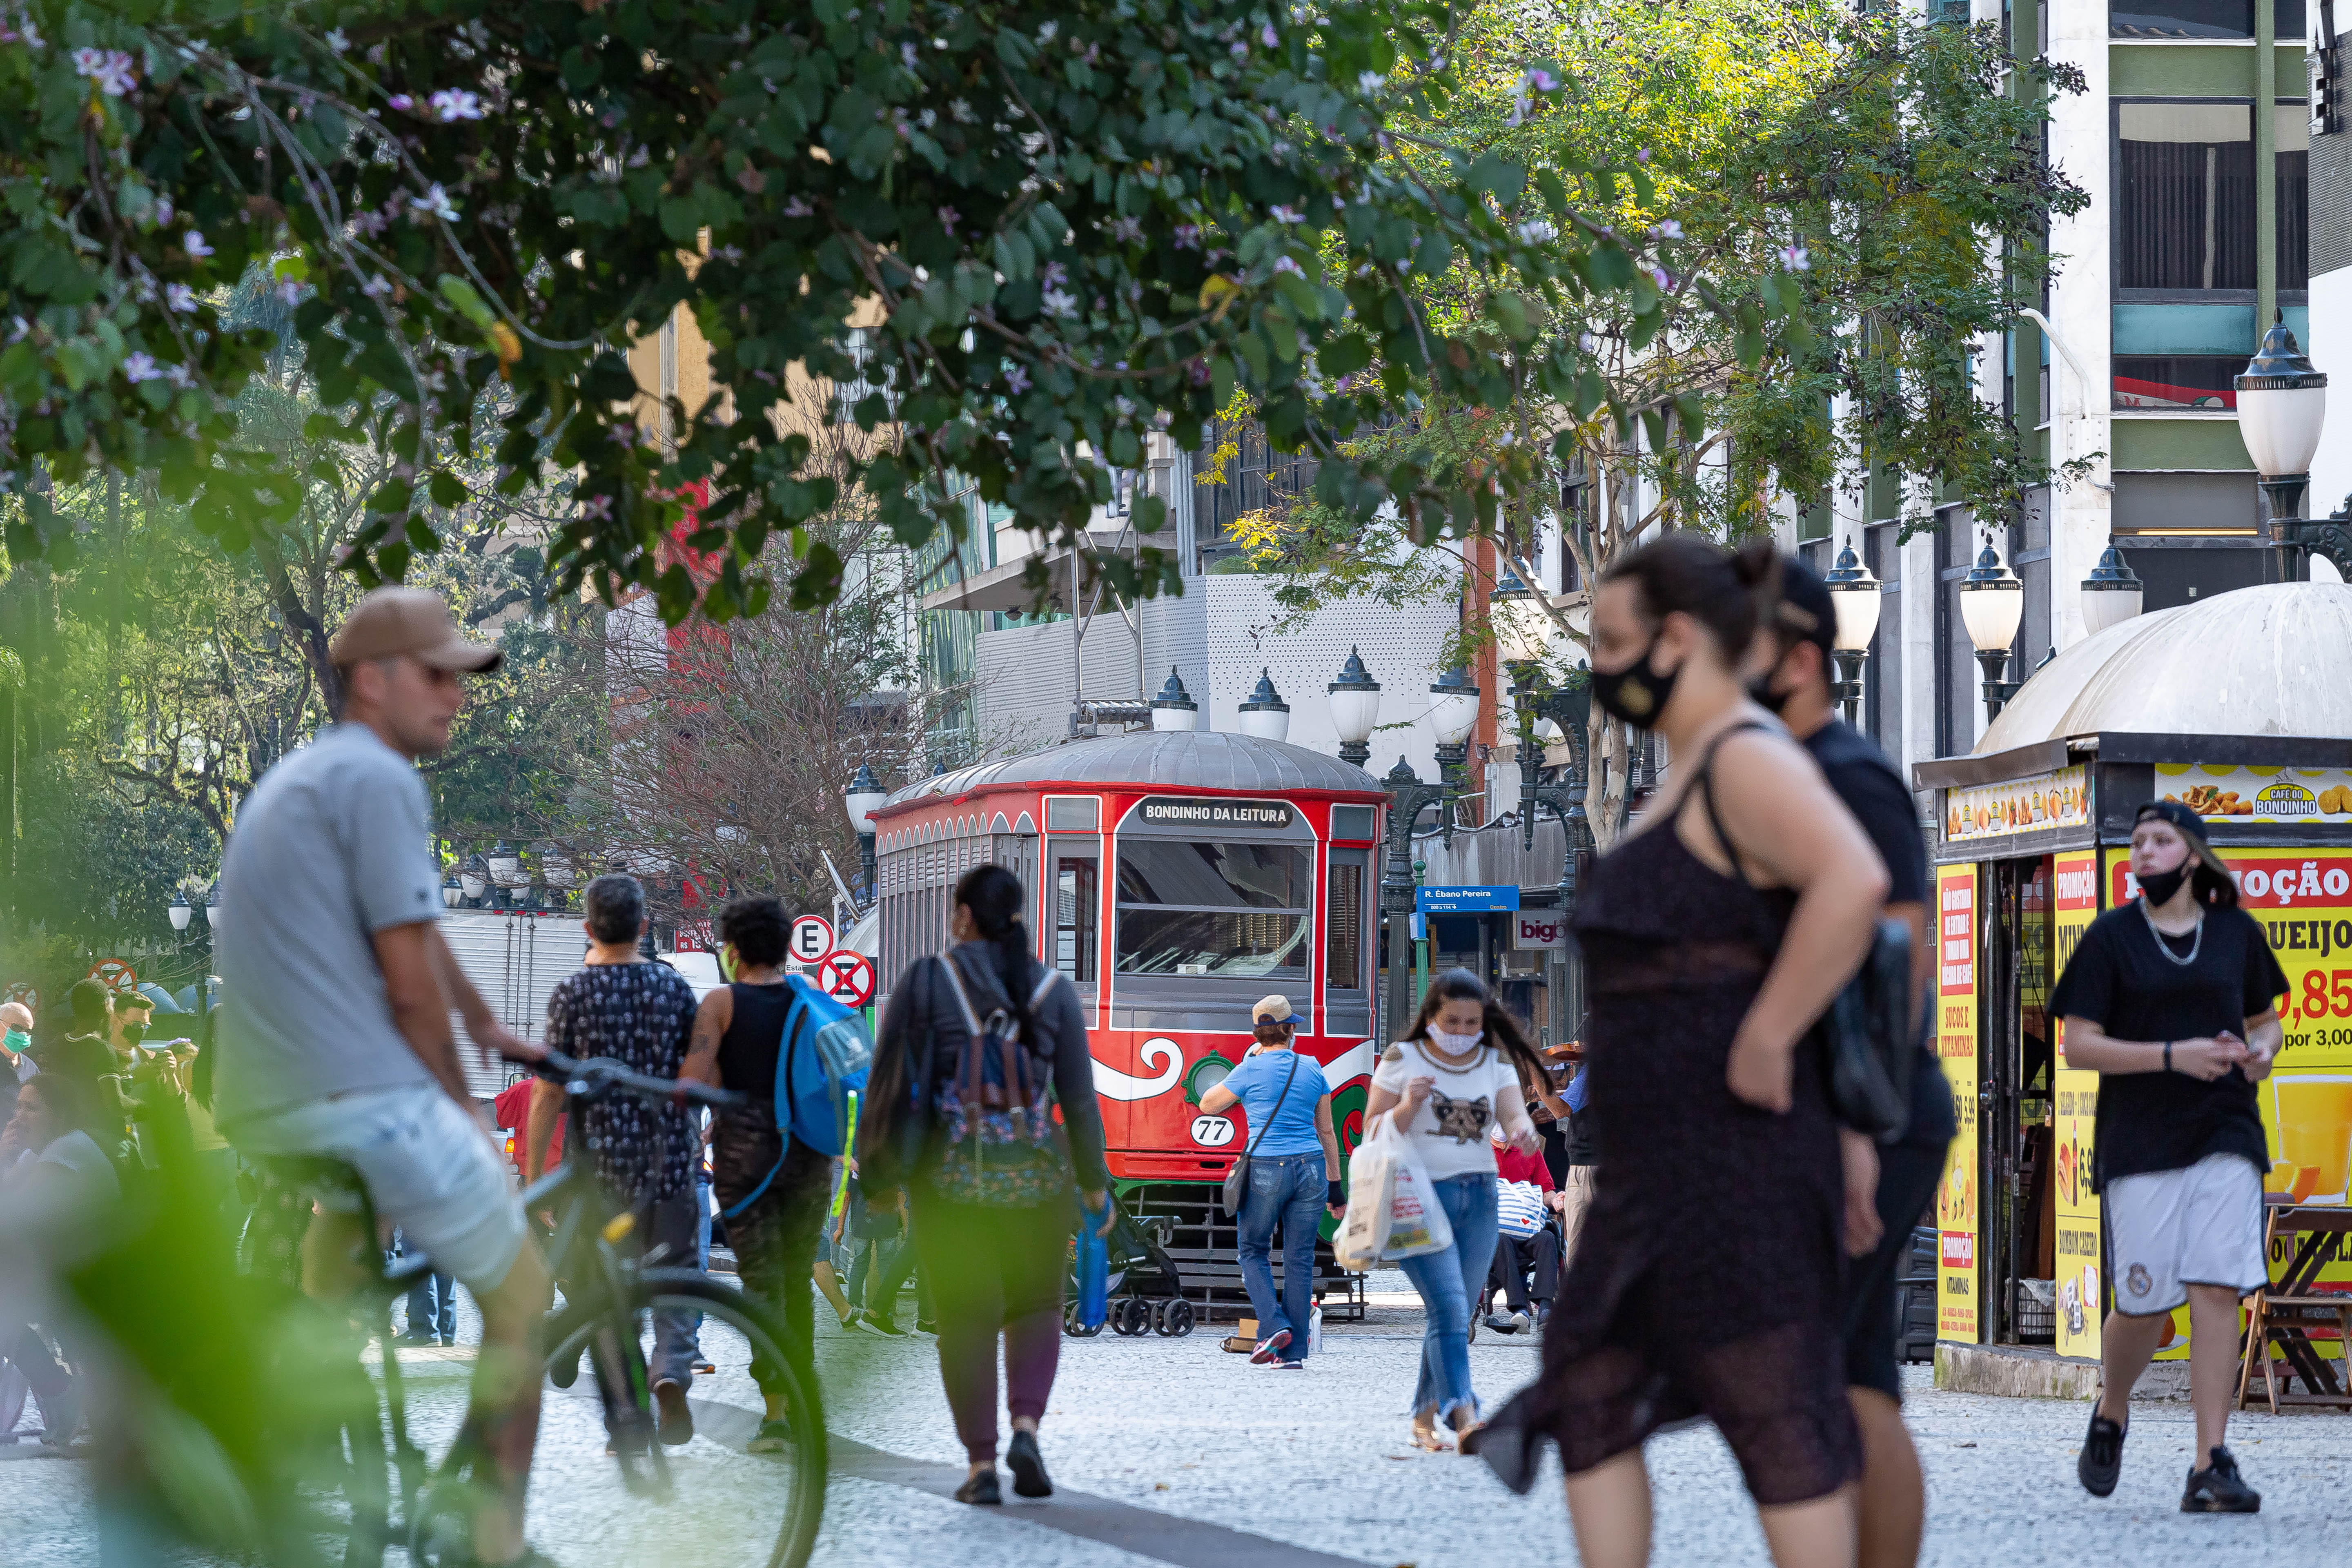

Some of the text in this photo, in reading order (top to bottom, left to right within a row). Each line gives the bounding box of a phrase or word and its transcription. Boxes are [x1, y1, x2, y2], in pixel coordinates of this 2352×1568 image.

[2271, 788, 2302, 799] CAFÉ DO
[1146, 805, 1287, 822] BONDINHO DA LEITURA
[2256, 800, 2316, 814] BONDINHO
[1435, 889, 1461, 898] Ébano
[2058, 862, 2095, 906] PROMOÇÃO
[802, 925, 819, 953] E
[1945, 1006, 1969, 1029] SUCOS E
[1941, 1035, 1973, 1058] VITAMINAS
[2285, 1029, 2352, 1050] por 3,00
[1198, 1120, 1227, 1140] 77
[2080, 1147, 2093, 1199] 6,9
[1943, 1232, 1972, 1265] PROMOÇÃO
